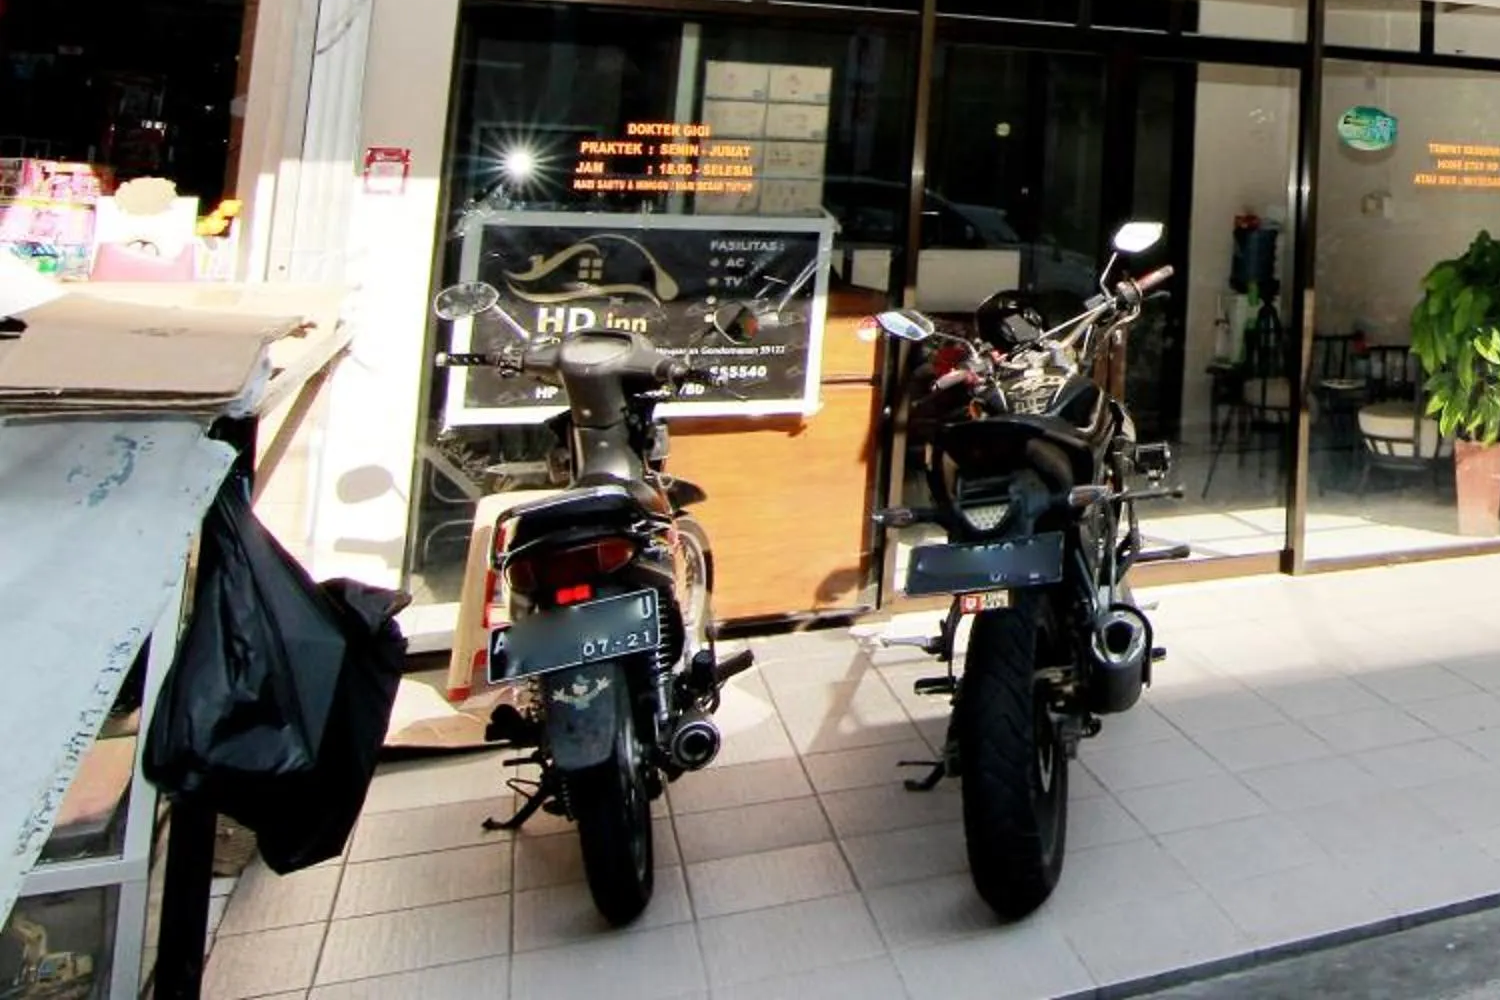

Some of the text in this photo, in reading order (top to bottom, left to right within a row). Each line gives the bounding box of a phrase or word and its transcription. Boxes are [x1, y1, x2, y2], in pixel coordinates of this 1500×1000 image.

[628, 122, 712, 138] DOKTER GIGI
[580, 141, 643, 155] PRAKTEK
[659, 143, 699, 156] SENIN
[709, 144, 752, 157] JUMAT
[575, 161, 605, 174] JAM
[702, 163, 754, 177] SELESAI
[725, 257, 746, 268] AC
[724, 276, 744, 288] TV
[536, 307, 648, 334] HD inn
[536, 386, 559, 399] HP
